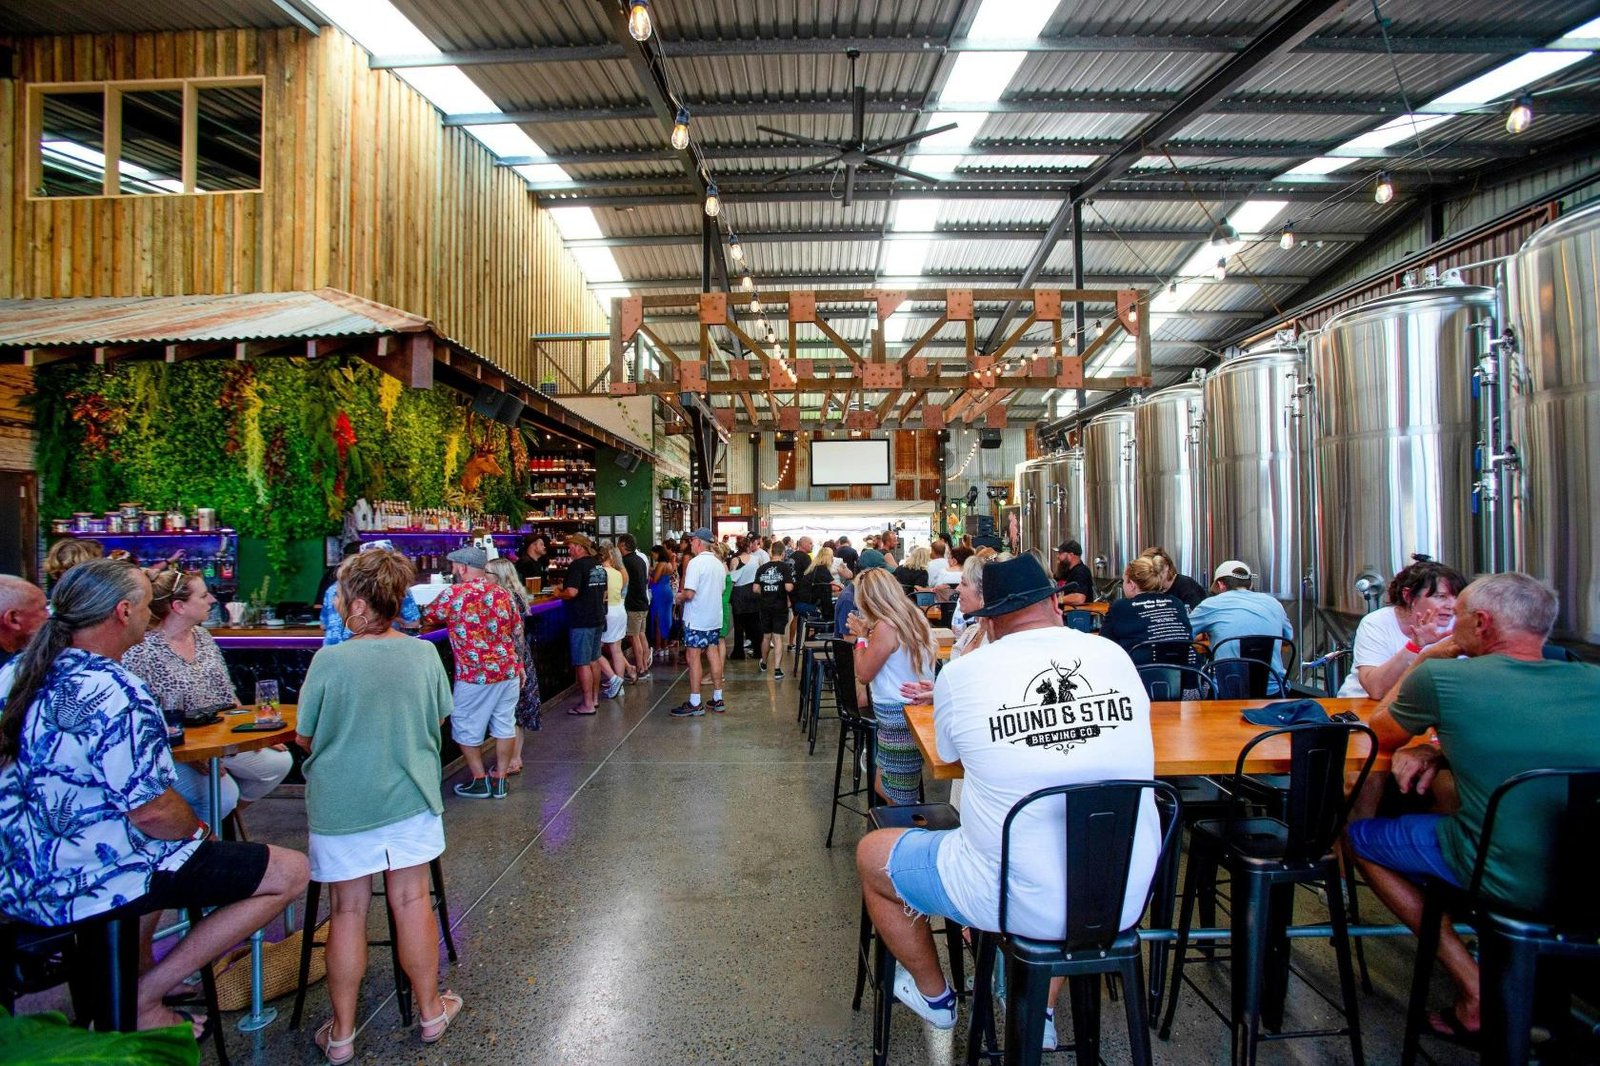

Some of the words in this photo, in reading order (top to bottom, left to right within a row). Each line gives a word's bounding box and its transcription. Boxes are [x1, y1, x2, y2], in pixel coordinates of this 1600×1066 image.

[988, 707, 1058, 743] HOUND
[1061, 705, 1076, 725] &
[1080, 696, 1133, 722] STAG
[1031, 729, 1076, 744] BREWING
[1079, 727, 1097, 740] CO.
